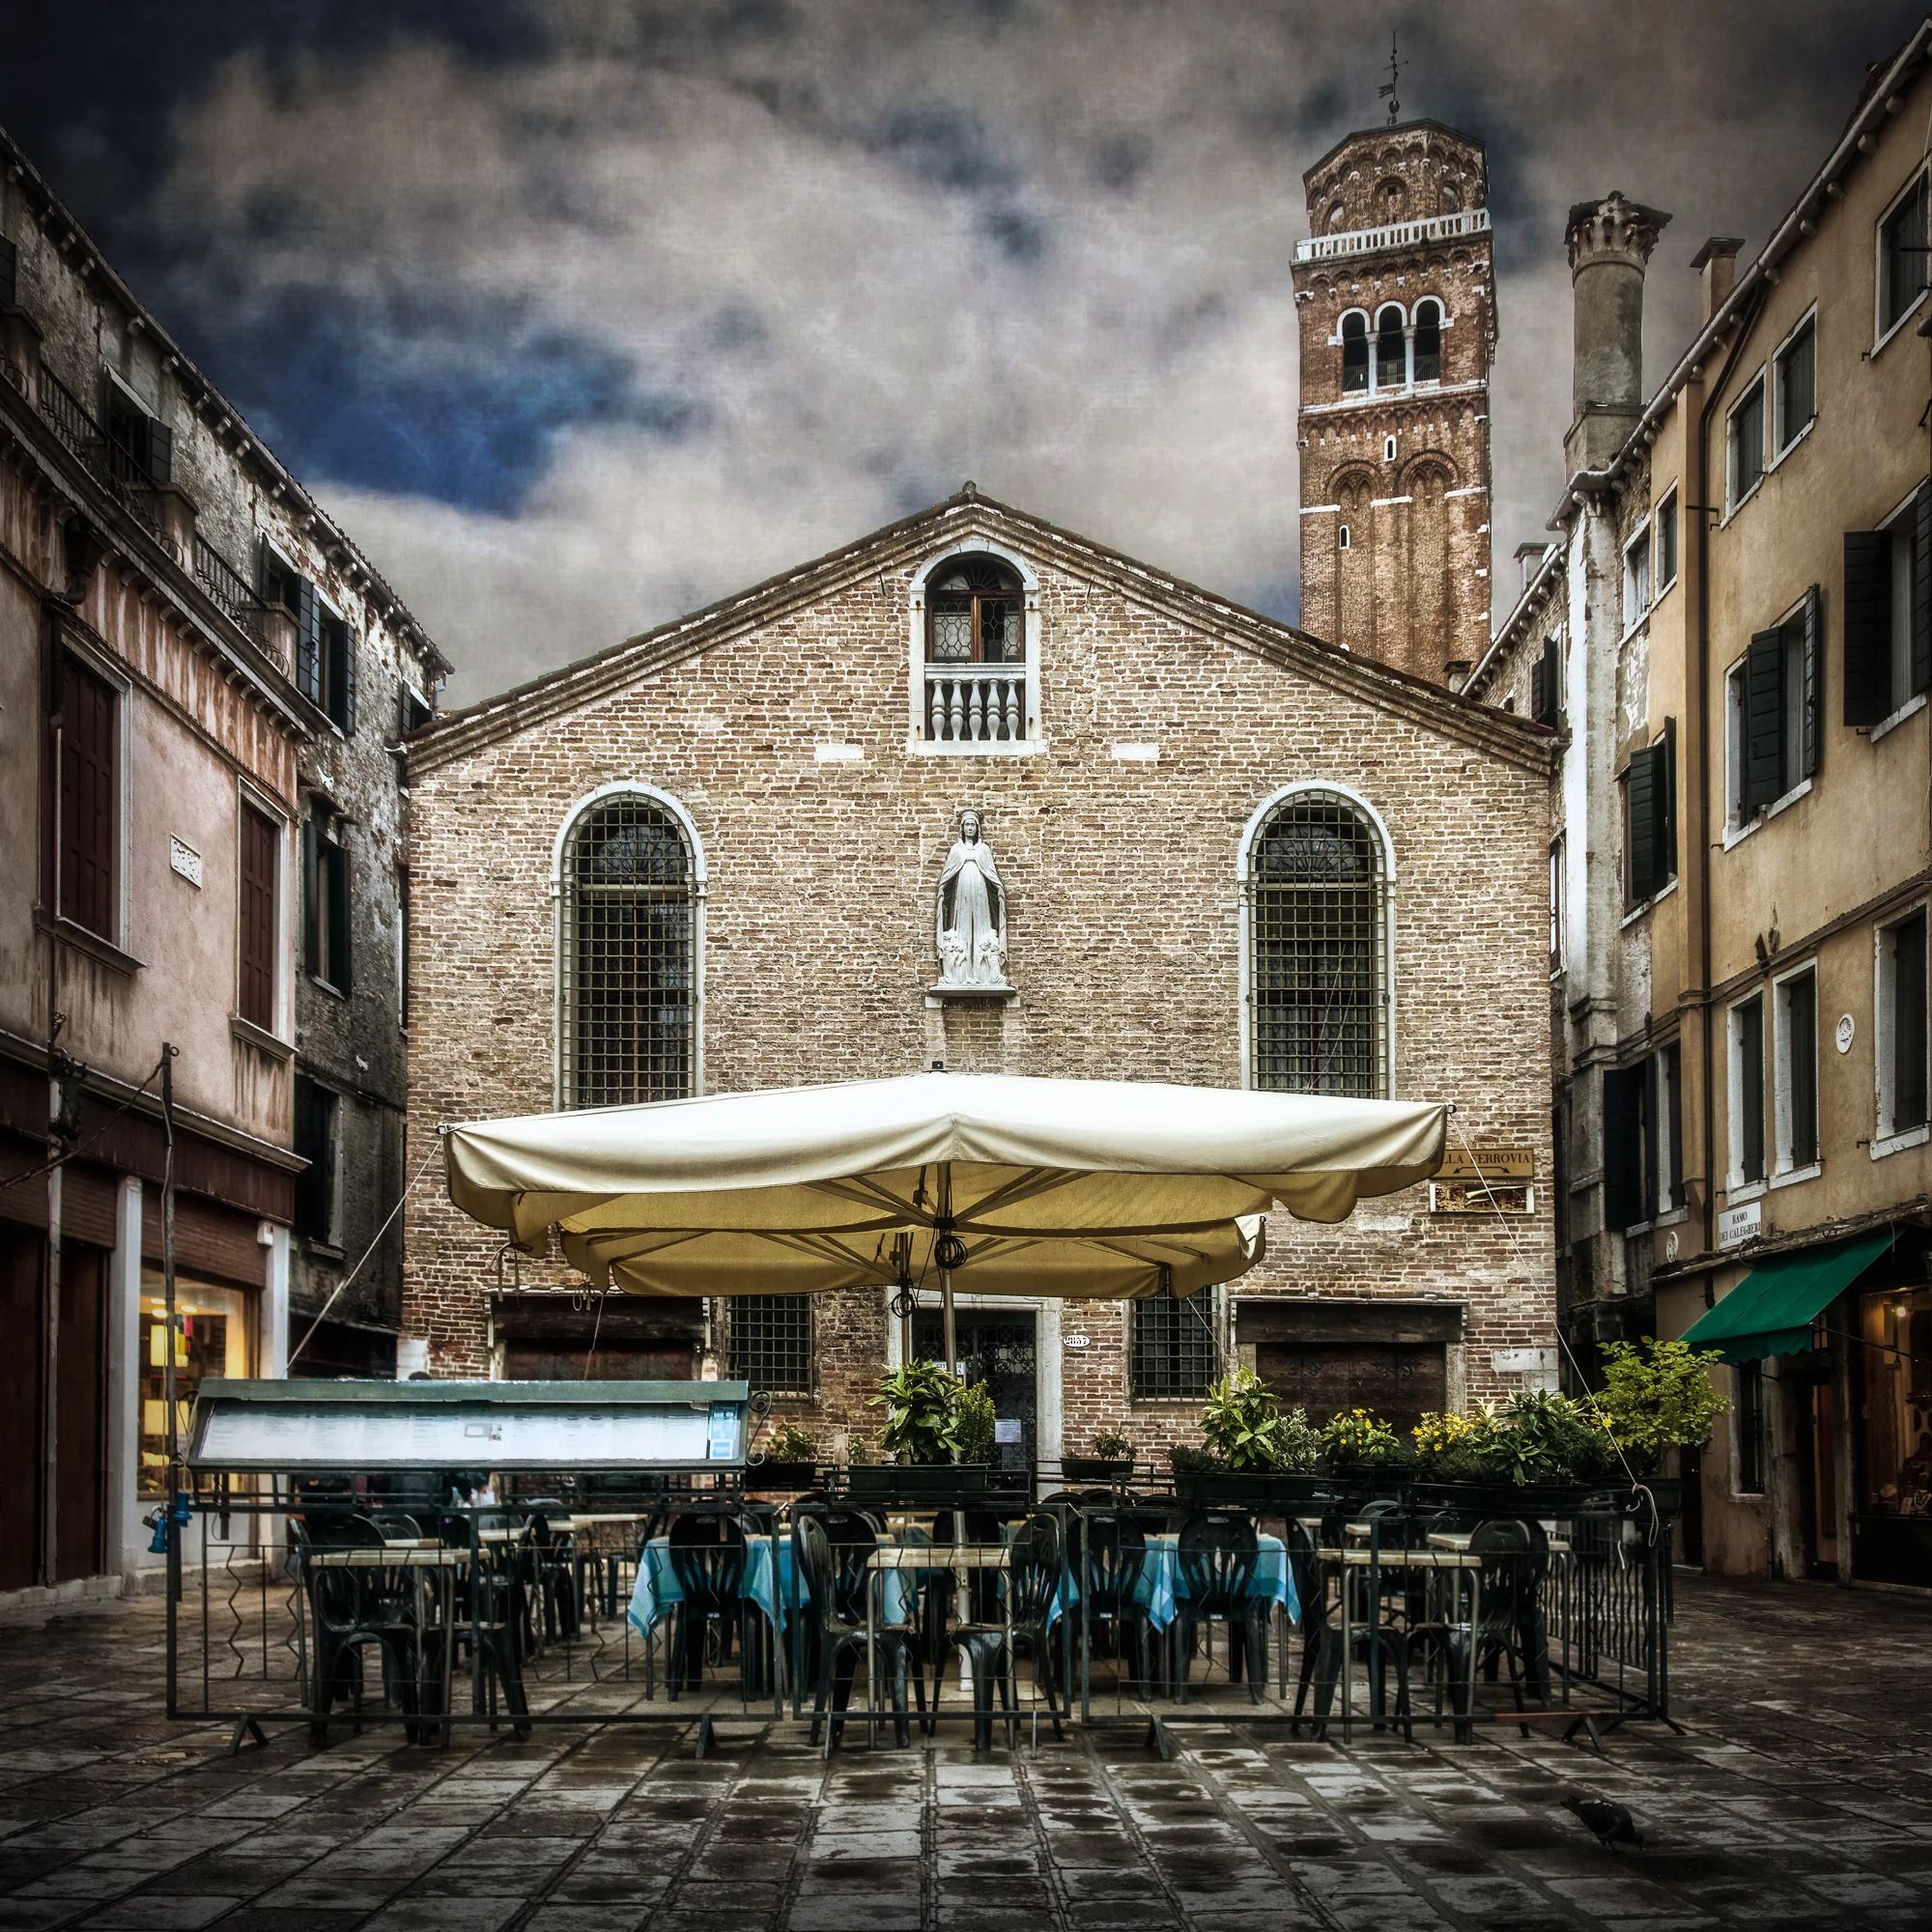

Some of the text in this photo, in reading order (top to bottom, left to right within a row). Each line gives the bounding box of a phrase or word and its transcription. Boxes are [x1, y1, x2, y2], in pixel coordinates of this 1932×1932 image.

[1470, 1152, 1530, 1164] FERROVIA
[1732, 1211, 1747, 1225] RAMO
[1719, 1221, 1761, 1243] DEI CALEGHERI
